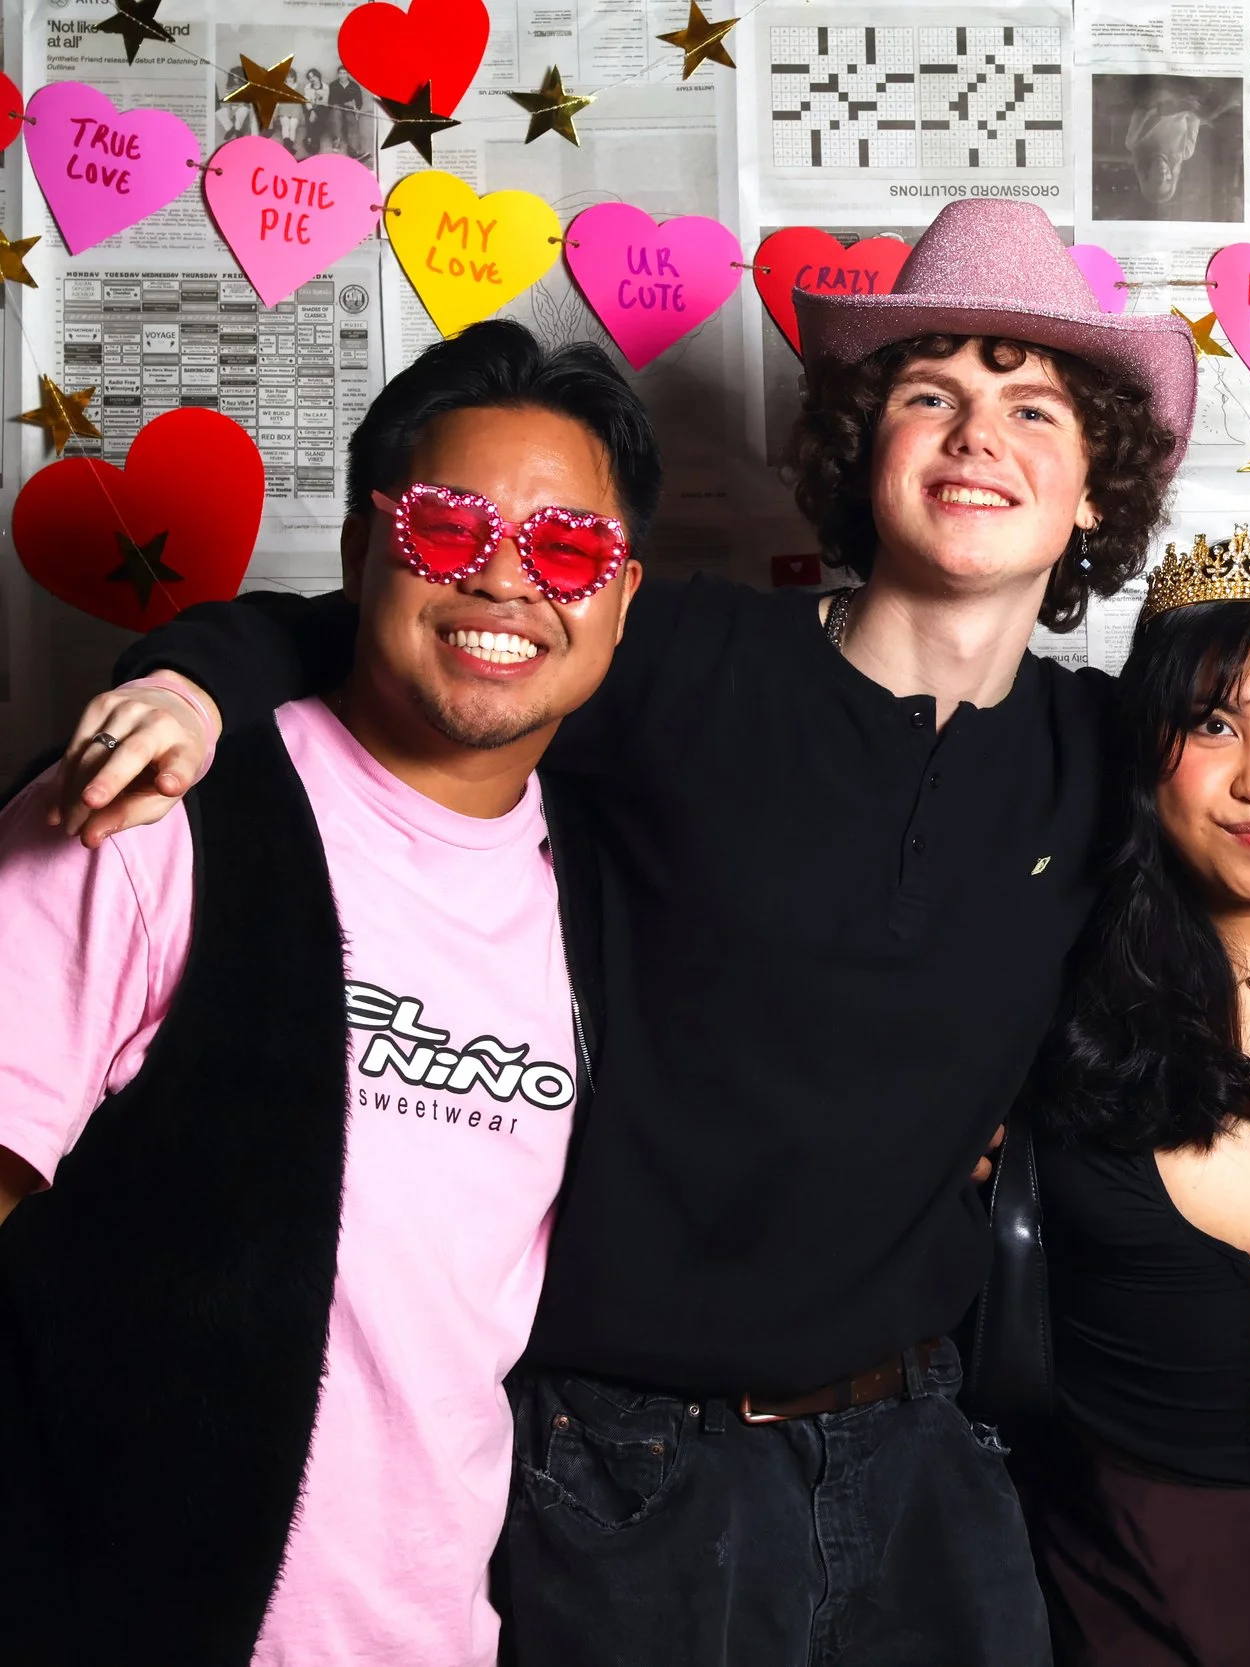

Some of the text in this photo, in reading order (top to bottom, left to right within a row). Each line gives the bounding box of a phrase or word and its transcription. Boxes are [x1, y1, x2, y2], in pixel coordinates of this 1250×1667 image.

[48, 37, 83, 49] at all’
[48, 55, 80, 65] Synthetic
[81, 56, 103, 64] Friend
[136, 57, 155, 65] debut
[168, 58, 199, 66] Catching
[70, 118, 141, 160] TRUE
[66, 155, 131, 194] LOVE
[251, 167, 335, 210] CUTIE
[889, 185, 1060, 197] CROSSWORD SOLUTIONS
[260, 208, 311, 245] PIE
[436, 211, 498, 252] MY
[104, 271, 140, 279] TUESDAY
[426, 246, 502, 284] LOVE
[627, 245, 680, 278] UR
[795, 265, 880, 294] CRAZY
[618, 284, 687, 312] CUTE
[145, 331, 176, 339] VOYAGE
[1071, 653, 1088, 663] City
[345, 979, 451, 1046] EL
[358, 1088, 518, 1135] sweetwear
